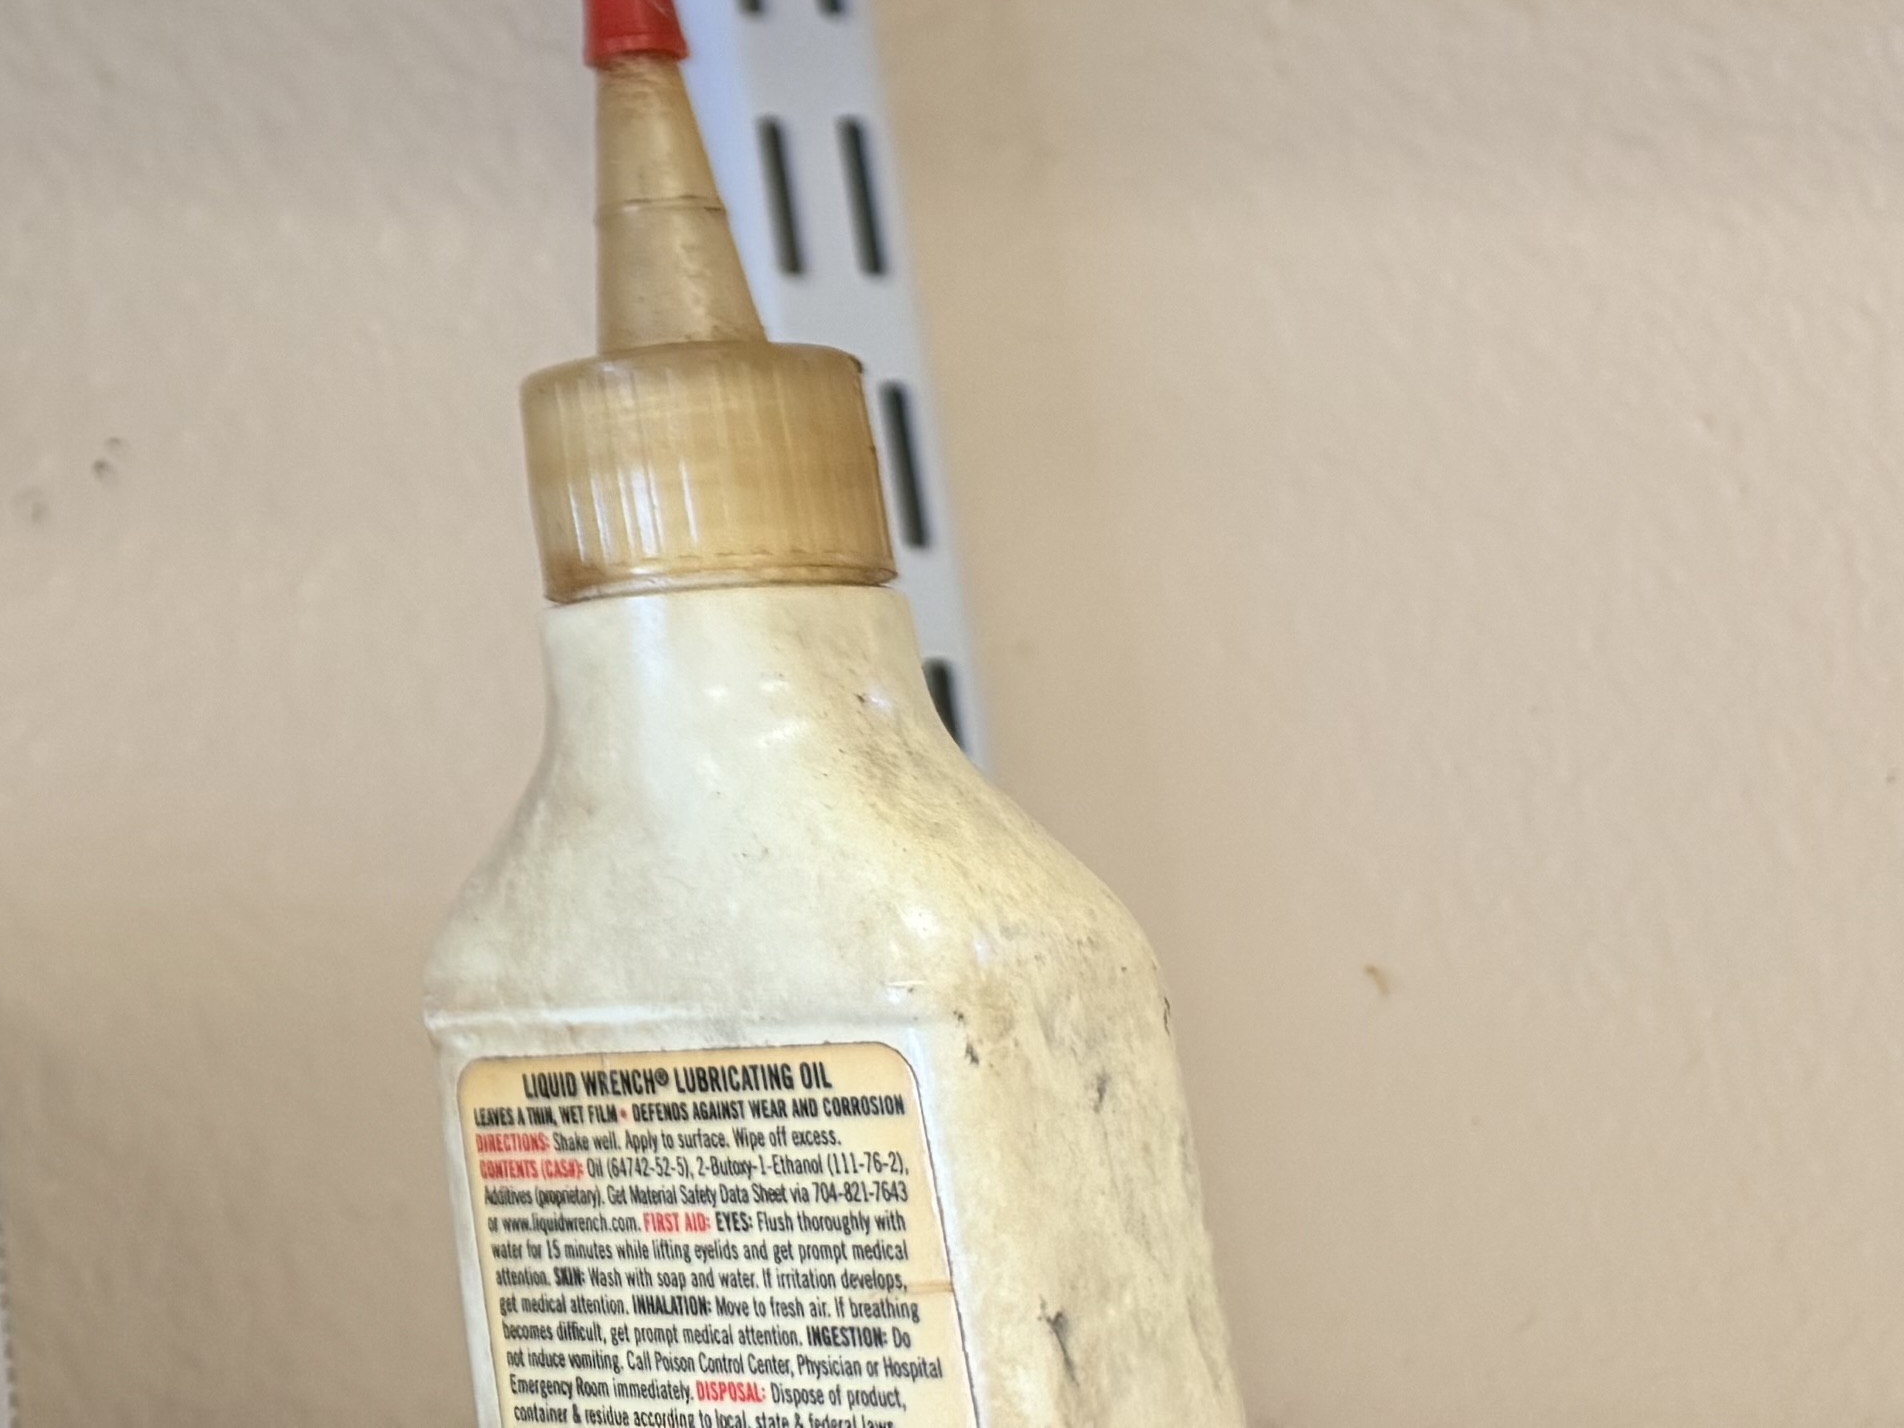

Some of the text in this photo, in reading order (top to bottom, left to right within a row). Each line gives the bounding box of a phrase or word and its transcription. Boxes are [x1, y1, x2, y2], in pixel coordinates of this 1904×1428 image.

[522, 1071, 577, 1099] LIQUID
[674, 1062, 794, 1094] LUBRICATING
[800, 1062, 832, 1089] OIL
[474, 1093, 905, 1126] LEAVES A THIN, WET FILM DEFENDS AGAINST WEAR AND CORROSION
[476, 1126, 842, 1153] DIRECTIONS: Shake well. Apply to surface. Wipe off excess.
[480, 1159, 539, 1180] CONTENTS
[587, 1159, 603, 1178] Oil
[485, 1185, 532, 1205] Additives
[607, 1185, 626, 1205] Get
[631, 1184, 677, 1205] Material
[680, 1183, 717, 1207] Safety
[721, 1184, 749, 1204] Data
[752, 1183, 788, 1204] Sheet
[791, 1185, 810, 1203] via
[812, 1180, 909, 1203] 704-821-7643
[488, 1216, 498, 1233] or
[642, 1212, 680, 1233] FIRST
[685, 1211, 711, 1232] AID:
[716, 1212, 753, 1232] EYES:
[757, 1211, 794, 1232] Flush
[797, 1210, 870, 1235] thoroughly
[874, 1210, 906, 1232] with
